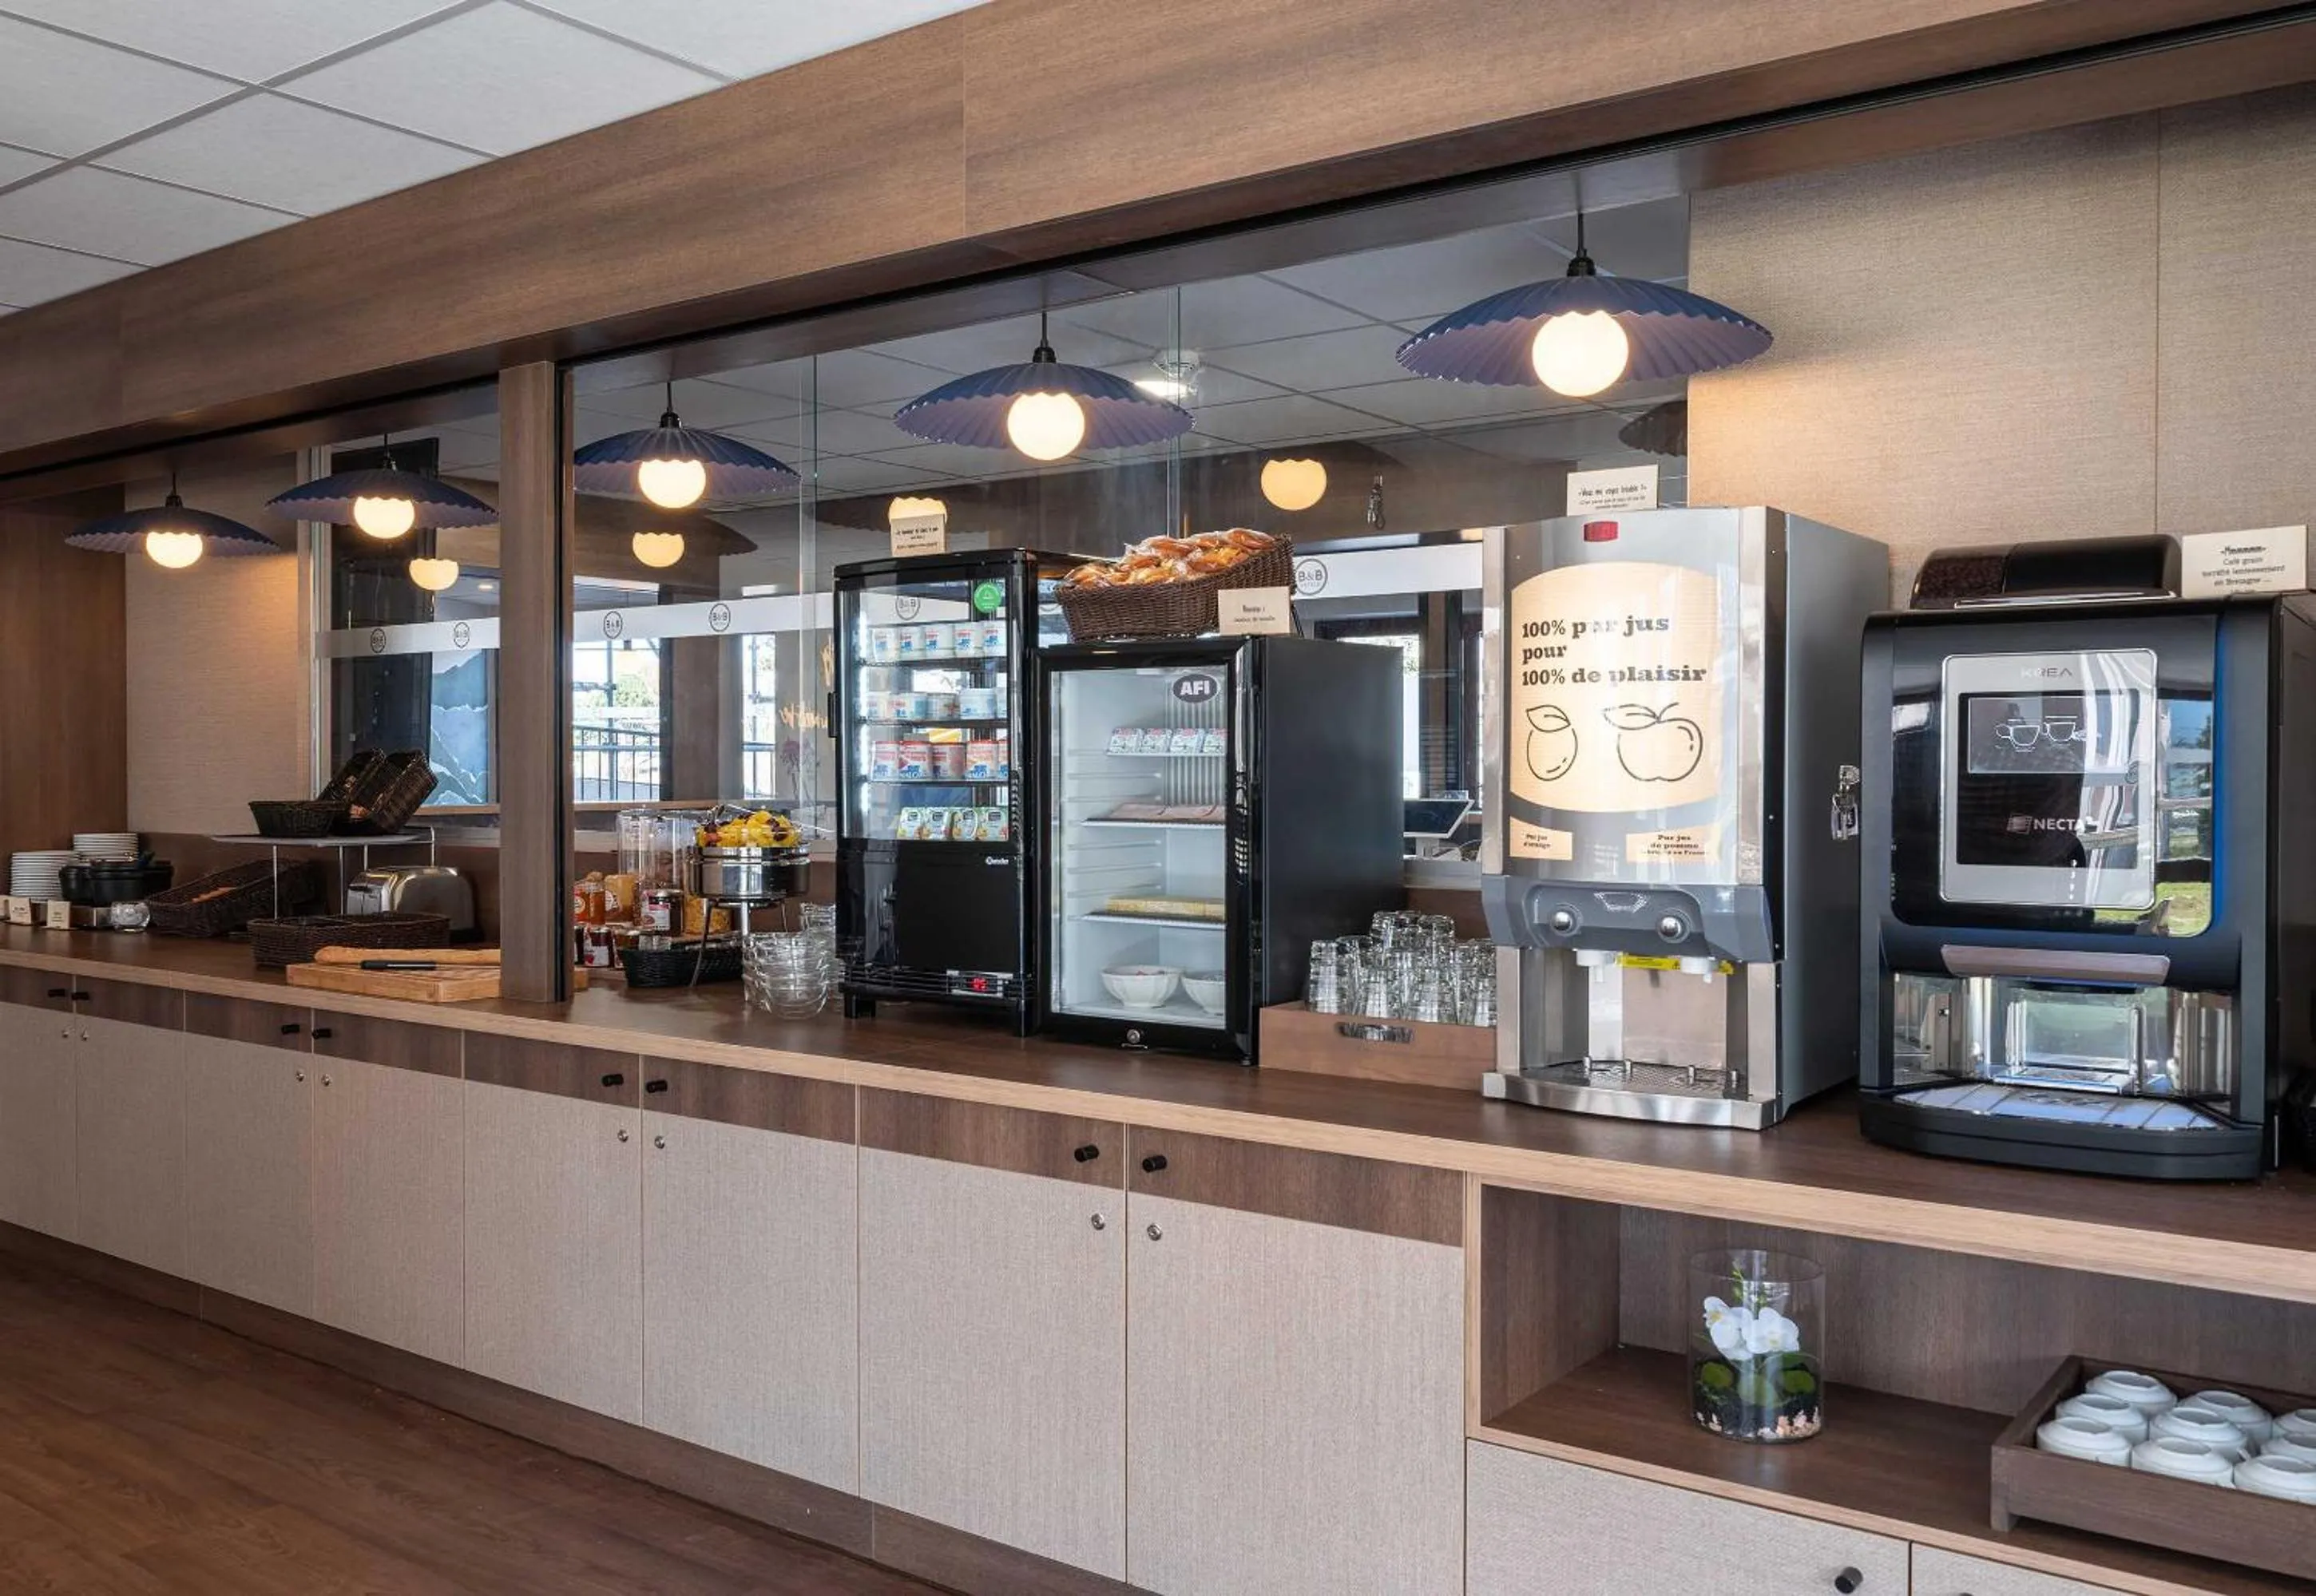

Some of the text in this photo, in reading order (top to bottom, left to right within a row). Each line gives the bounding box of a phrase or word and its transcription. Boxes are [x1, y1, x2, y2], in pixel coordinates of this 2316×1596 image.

[1521, 619, 1566, 638] 100%
[1623, 615, 1669, 637] jus
[1522, 644, 1567, 665] pour
[1521, 664, 1707, 687] 100% de plaisir
[1180, 680, 1211, 695] AFI
[2033, 818, 2085, 831] NECTA
